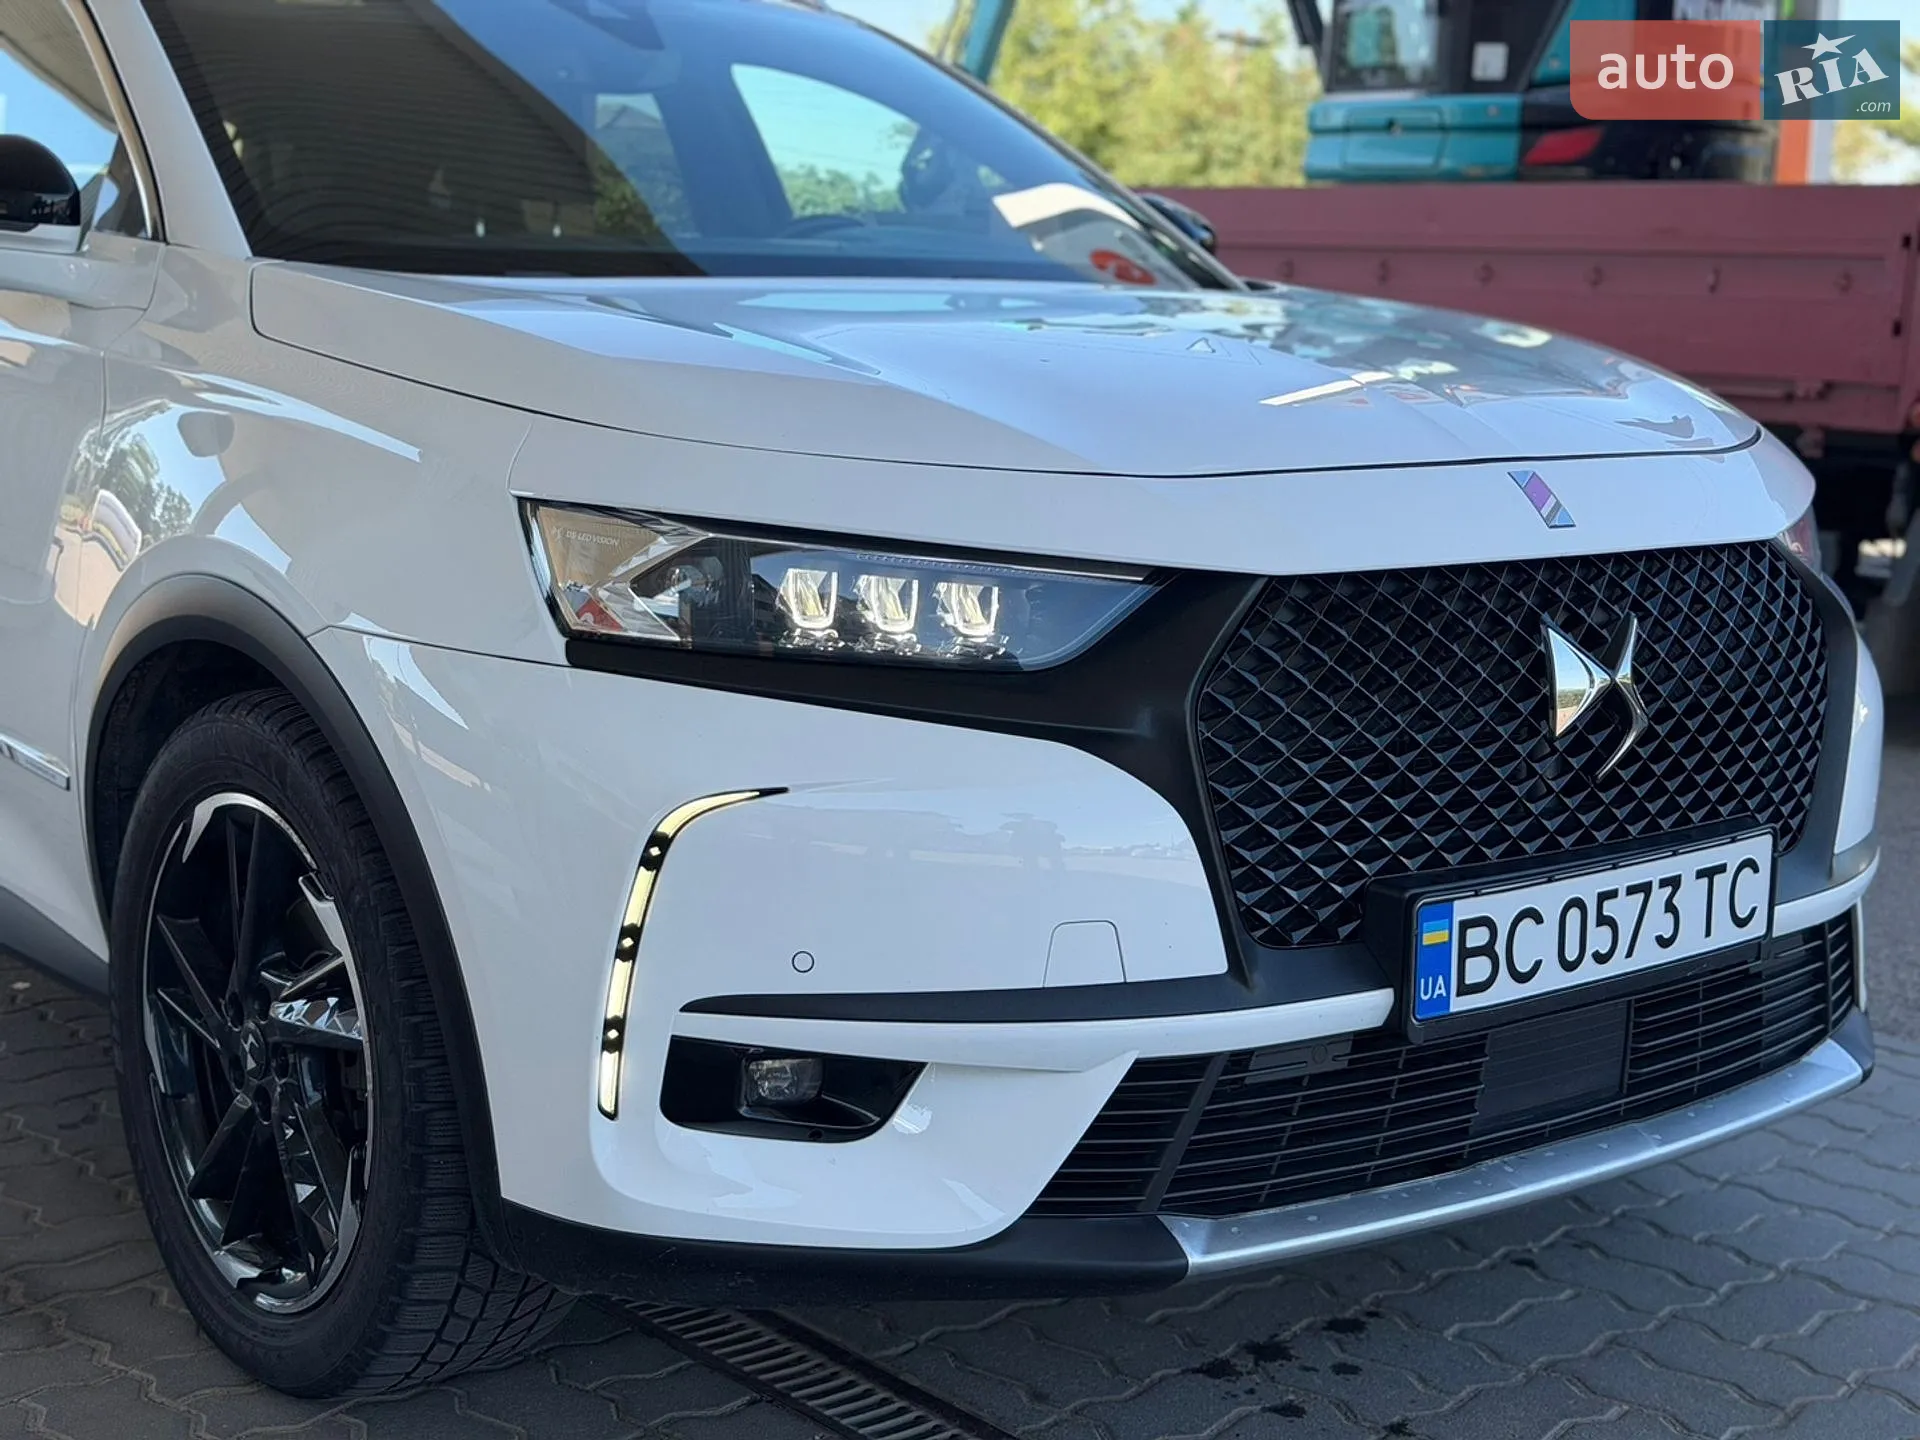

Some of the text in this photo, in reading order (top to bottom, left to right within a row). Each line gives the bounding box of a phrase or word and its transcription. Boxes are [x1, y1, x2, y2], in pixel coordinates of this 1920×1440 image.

[1455, 856, 1761, 998] BC 0573 TC
[1419, 974, 1448, 1001] UA
